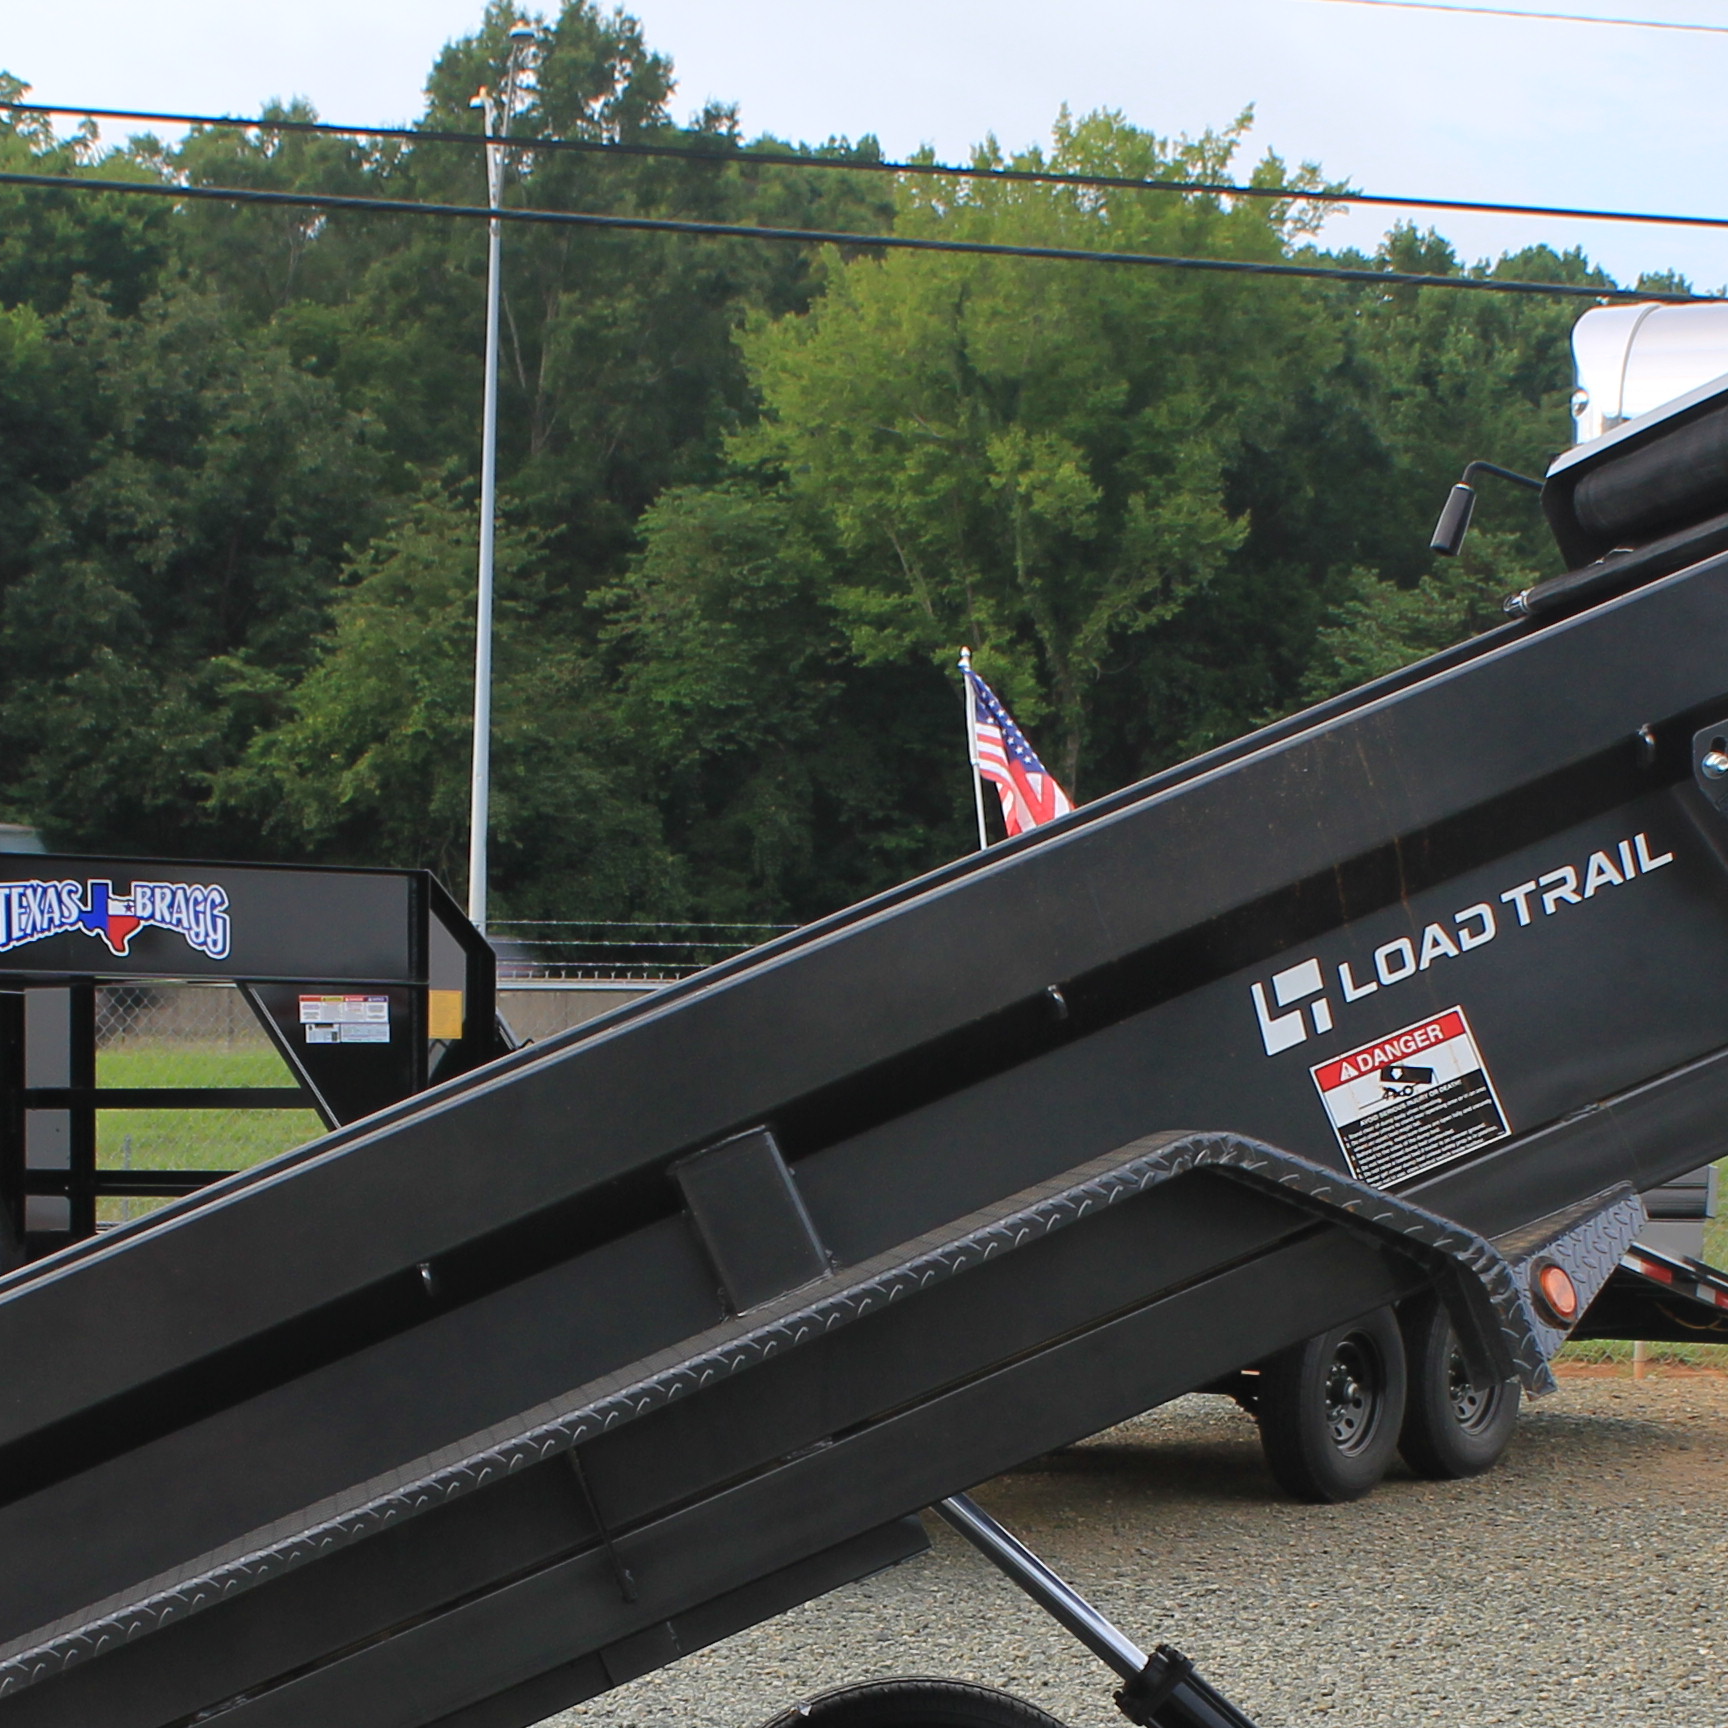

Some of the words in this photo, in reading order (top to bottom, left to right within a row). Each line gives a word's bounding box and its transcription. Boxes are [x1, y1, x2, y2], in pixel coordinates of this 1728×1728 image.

[130, 881, 231, 959] BRAGG
[1339, 903, 1497, 1002] LOAD
[1501, 833, 1674, 926] TRAIL
[1355, 1024, 1445, 1072] DANGER
